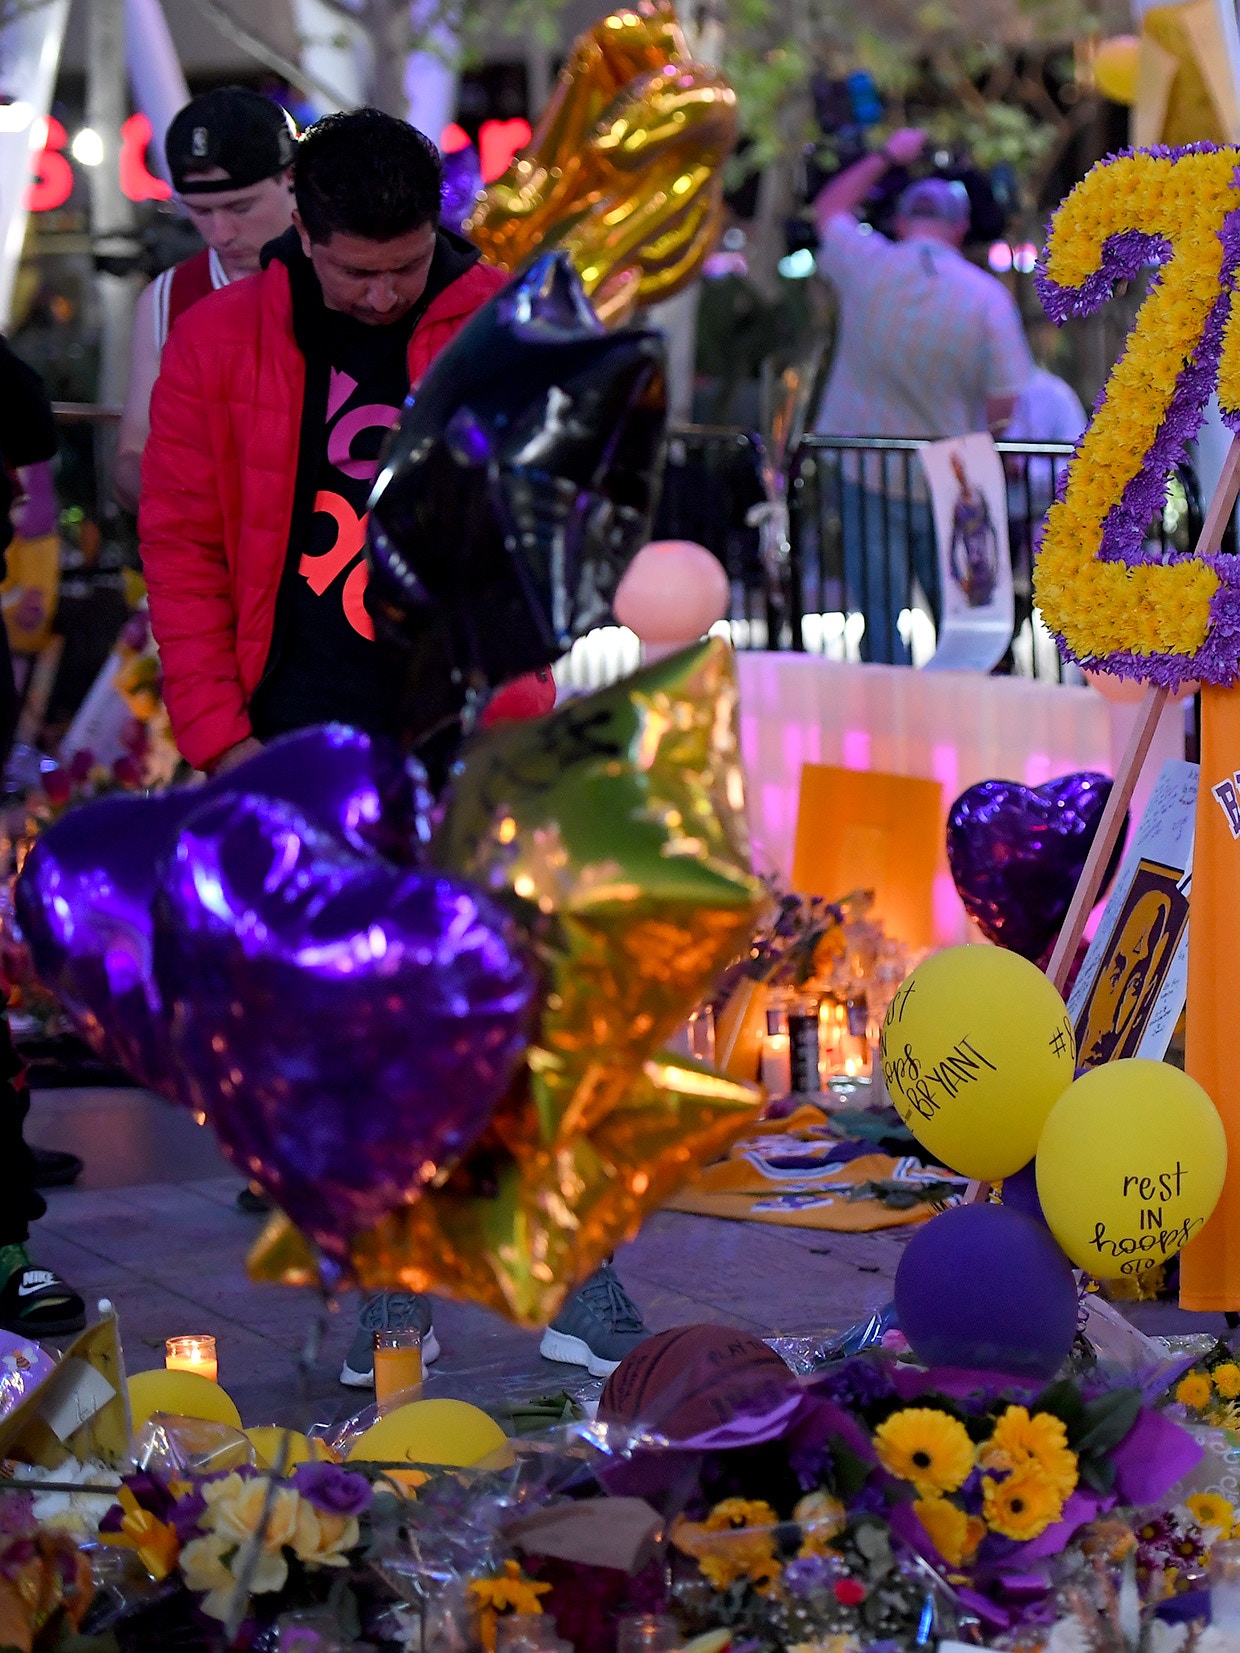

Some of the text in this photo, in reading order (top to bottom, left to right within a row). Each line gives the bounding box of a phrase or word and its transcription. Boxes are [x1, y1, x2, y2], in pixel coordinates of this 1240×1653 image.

[907, 1033, 997, 1121] BRYANT
[1123, 1161, 1188, 1202] rest
[1088, 1217, 1205, 1257] hoops
[1140, 1206, 1163, 1231] IN
[23, 1270, 55, 1286] NIKE
